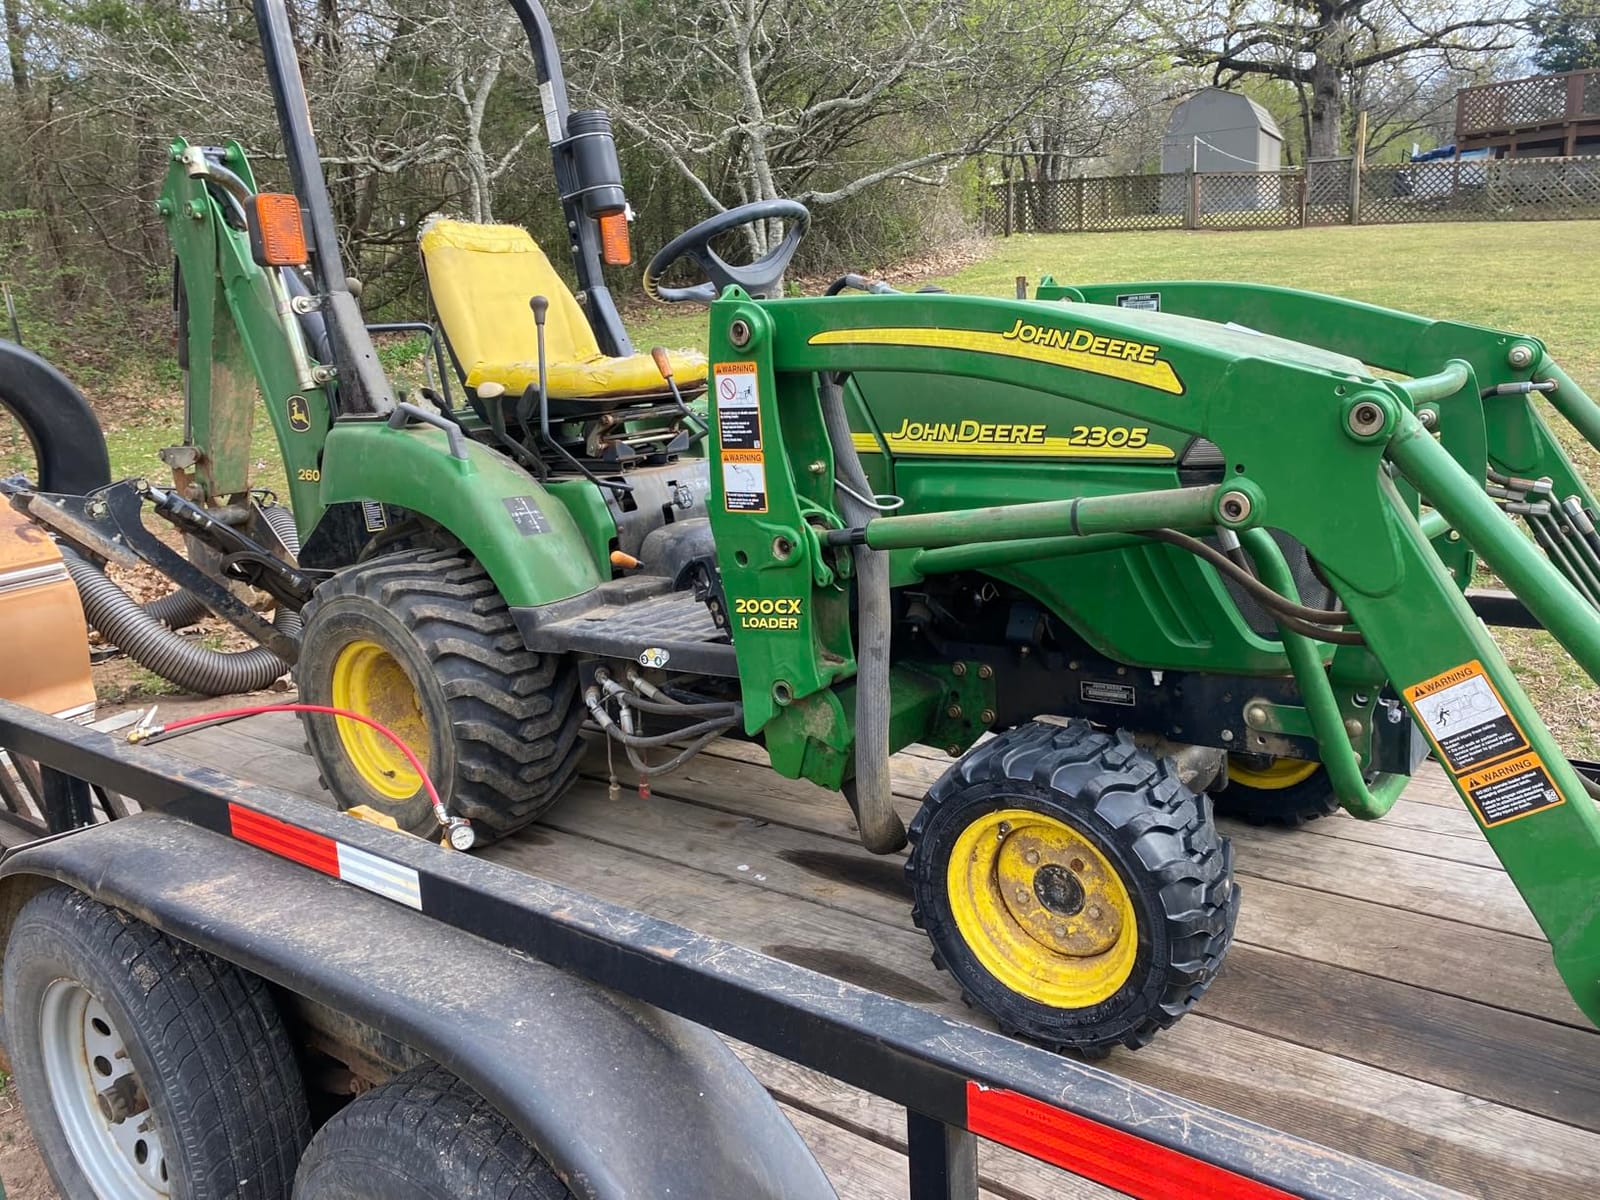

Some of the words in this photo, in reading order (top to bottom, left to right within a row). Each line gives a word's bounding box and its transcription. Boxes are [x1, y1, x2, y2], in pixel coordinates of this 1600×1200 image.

[722, 364, 754, 374] WARNING
[1069, 426, 1149, 448] 2305
[728, 453, 762, 462] WARNING
[298, 469, 320, 482] 260
[735, 598, 802, 614] 200CX
[742, 616, 798, 630] LOADER
[1424, 668, 1472, 692] WARNING
[1482, 760, 1532, 782] WARNING
